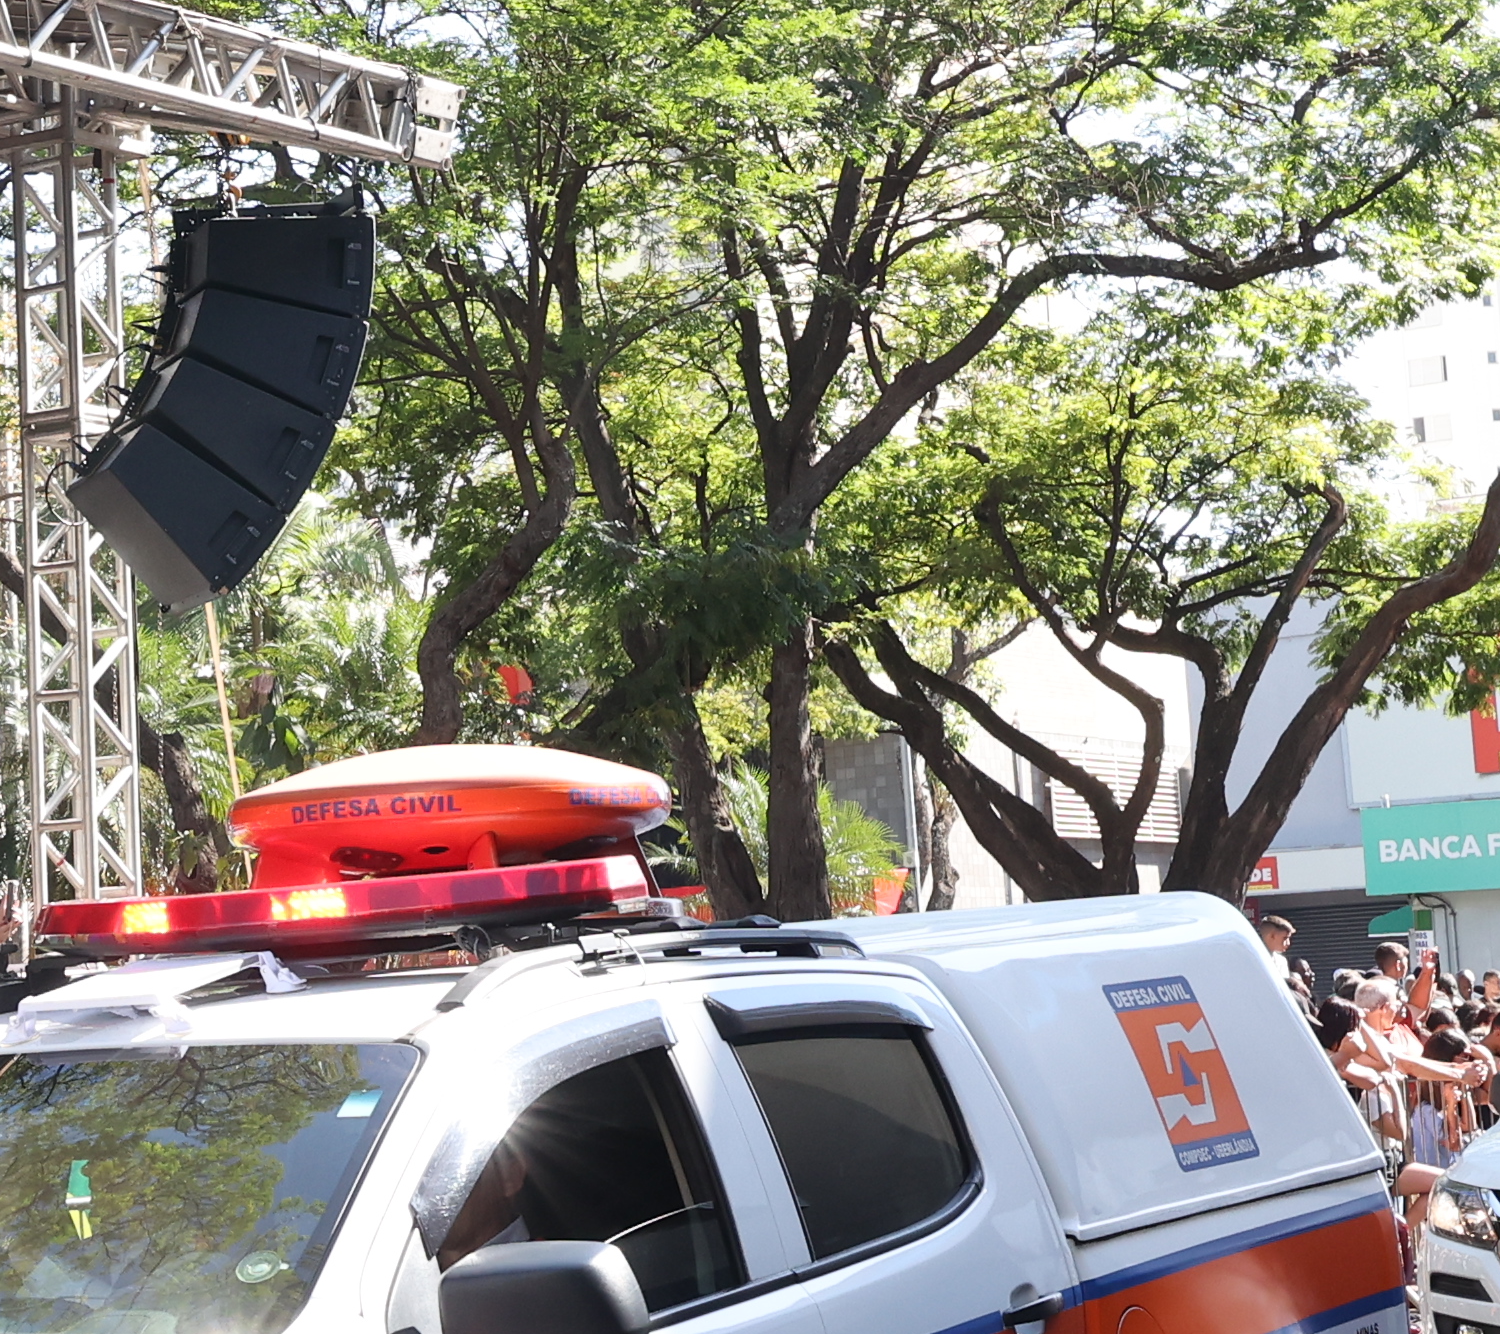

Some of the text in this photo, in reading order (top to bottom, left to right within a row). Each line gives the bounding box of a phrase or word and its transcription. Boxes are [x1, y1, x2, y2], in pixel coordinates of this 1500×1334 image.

[292, 794, 462, 825] DEFESA CIVIL
[1379, 835, 1482, 863] BANCA
[1110, 983, 1190, 1008] DEFESA CIVIL
